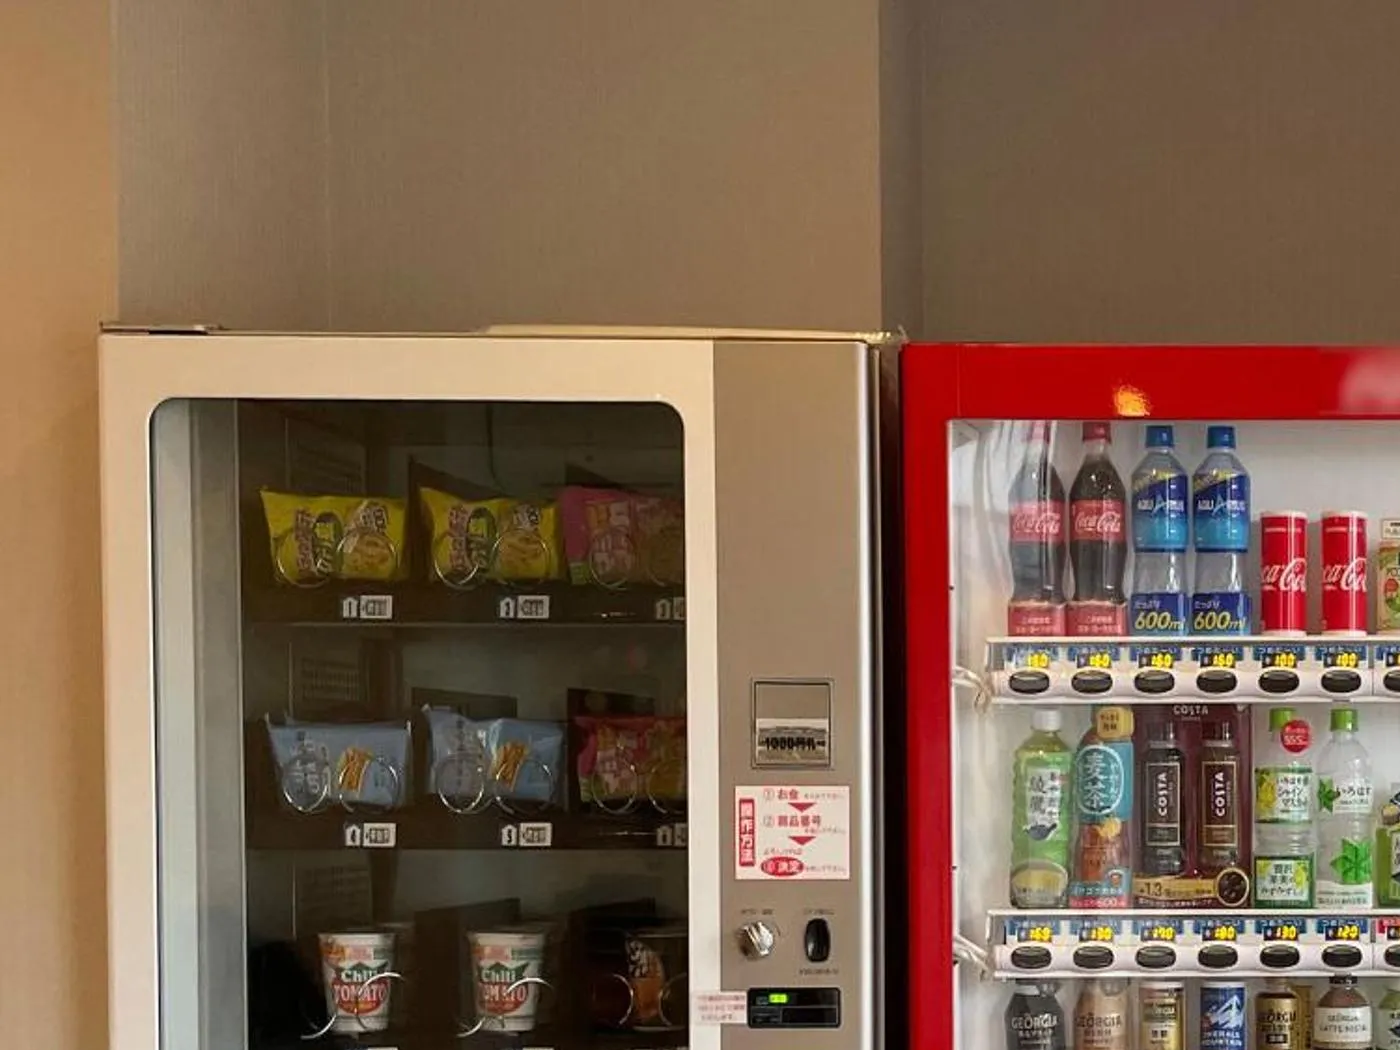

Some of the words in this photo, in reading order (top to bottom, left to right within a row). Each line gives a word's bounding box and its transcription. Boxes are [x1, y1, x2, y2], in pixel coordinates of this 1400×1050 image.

[1173, 705, 1209, 715] COSTA
[778, 789, 799, 800] お金
[1083, 751, 1106, 809] 麦茶
[1157, 772, 1168, 817] COSTA
[1215, 771, 1225, 818] COSTA
